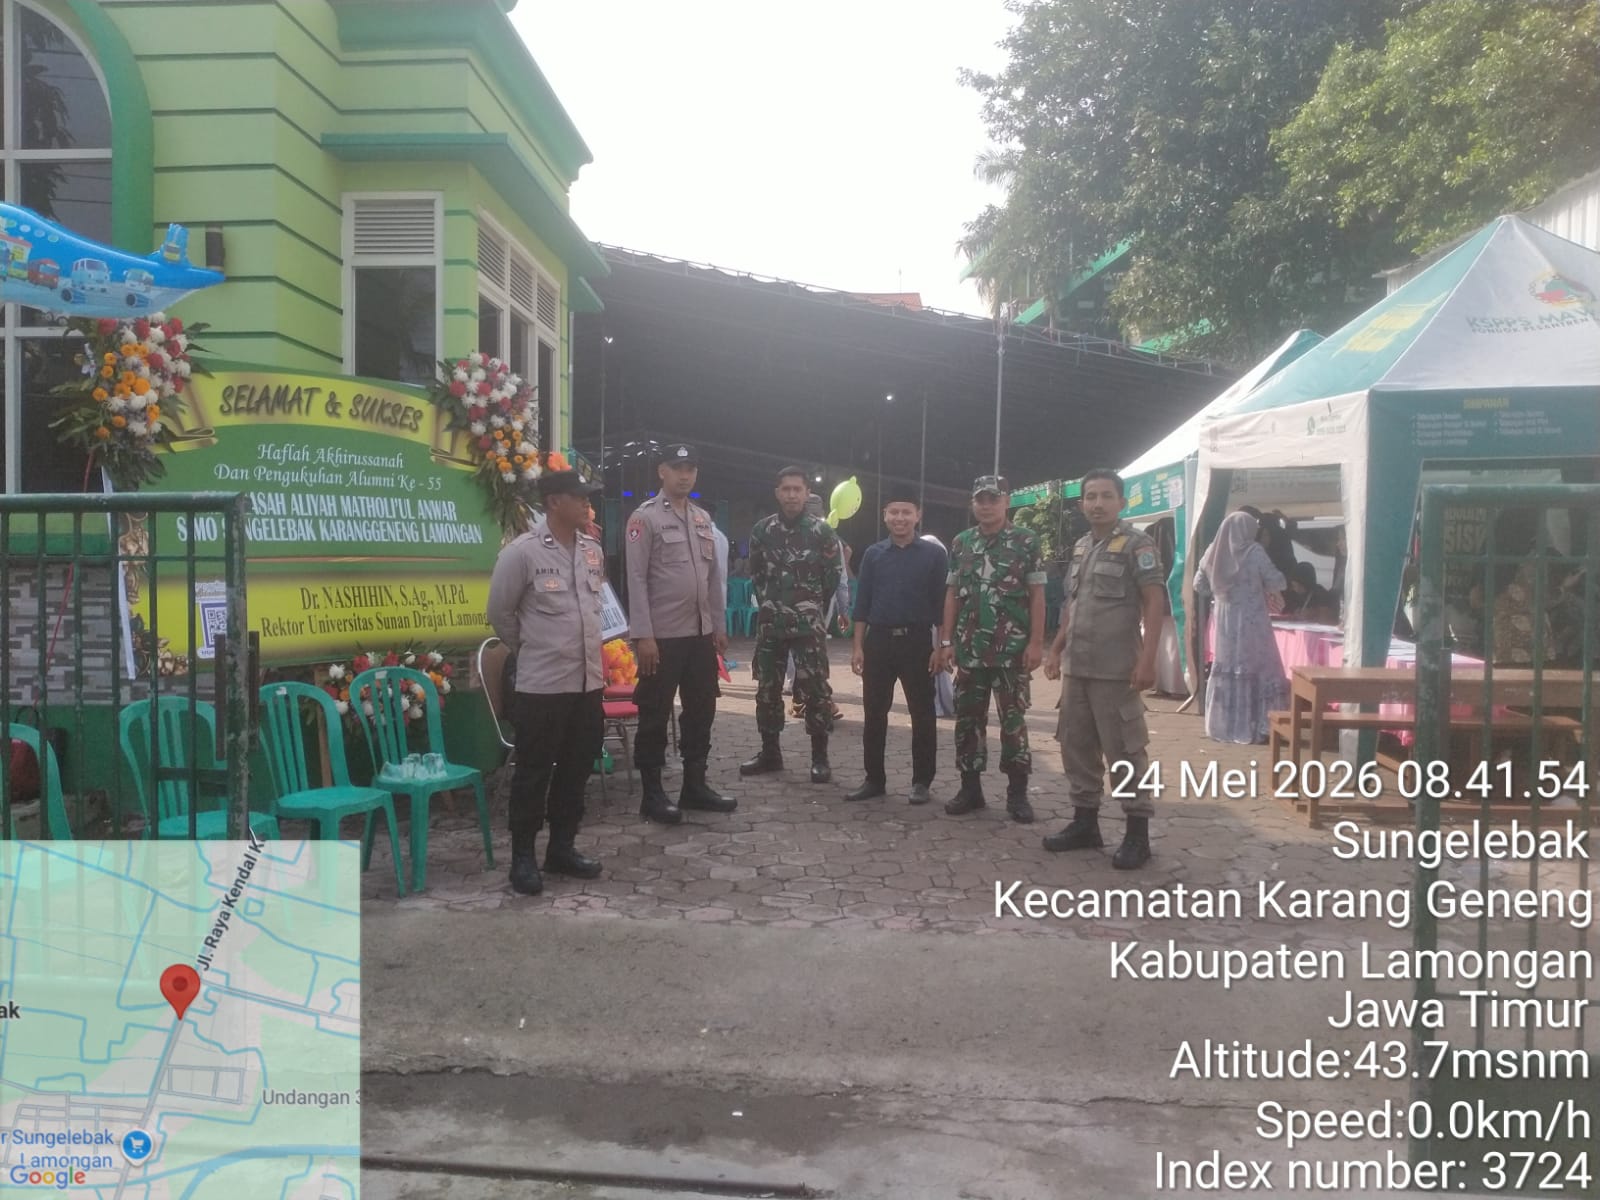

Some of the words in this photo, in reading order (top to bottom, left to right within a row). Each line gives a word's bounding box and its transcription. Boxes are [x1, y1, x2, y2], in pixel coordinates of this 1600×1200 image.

[219, 384, 321, 416] SELAMAT
[325, 391, 342, 418] &
[349, 393, 424, 432] SUKSES
[257, 443, 310, 463] Haflah
[313, 447, 404, 469] Akhirussanah
[214, 463, 249, 481] Dan
[253, 466, 342, 488] Pengukuhan
[346, 469, 395, 488] Alumni
[397, 474, 416, 491] Ke
[427, 477, 441, 491] 55
[291, 493, 337, 517] ALIYAH
[340, 495, 414, 520] MATHOLI'UL
[417, 500, 457, 521] ANWAR
[176, 516, 218, 542] SMO
[221, 516, 316, 542] NGELEBAK
[320, 522, 419, 543] KARANGGENENG
[422, 523, 483, 544] LAMONGAN
[300, 587, 320, 611] Dr.
[322, 585, 398, 609] NASHIHIN,
[436, 584, 469, 606] M.Pd.
[262, 616, 304, 638] Rektor
[307, 612, 374, 635] Universitas
[377, 611, 411, 630] Sunan
[413, 609, 447, 632] Drajat
